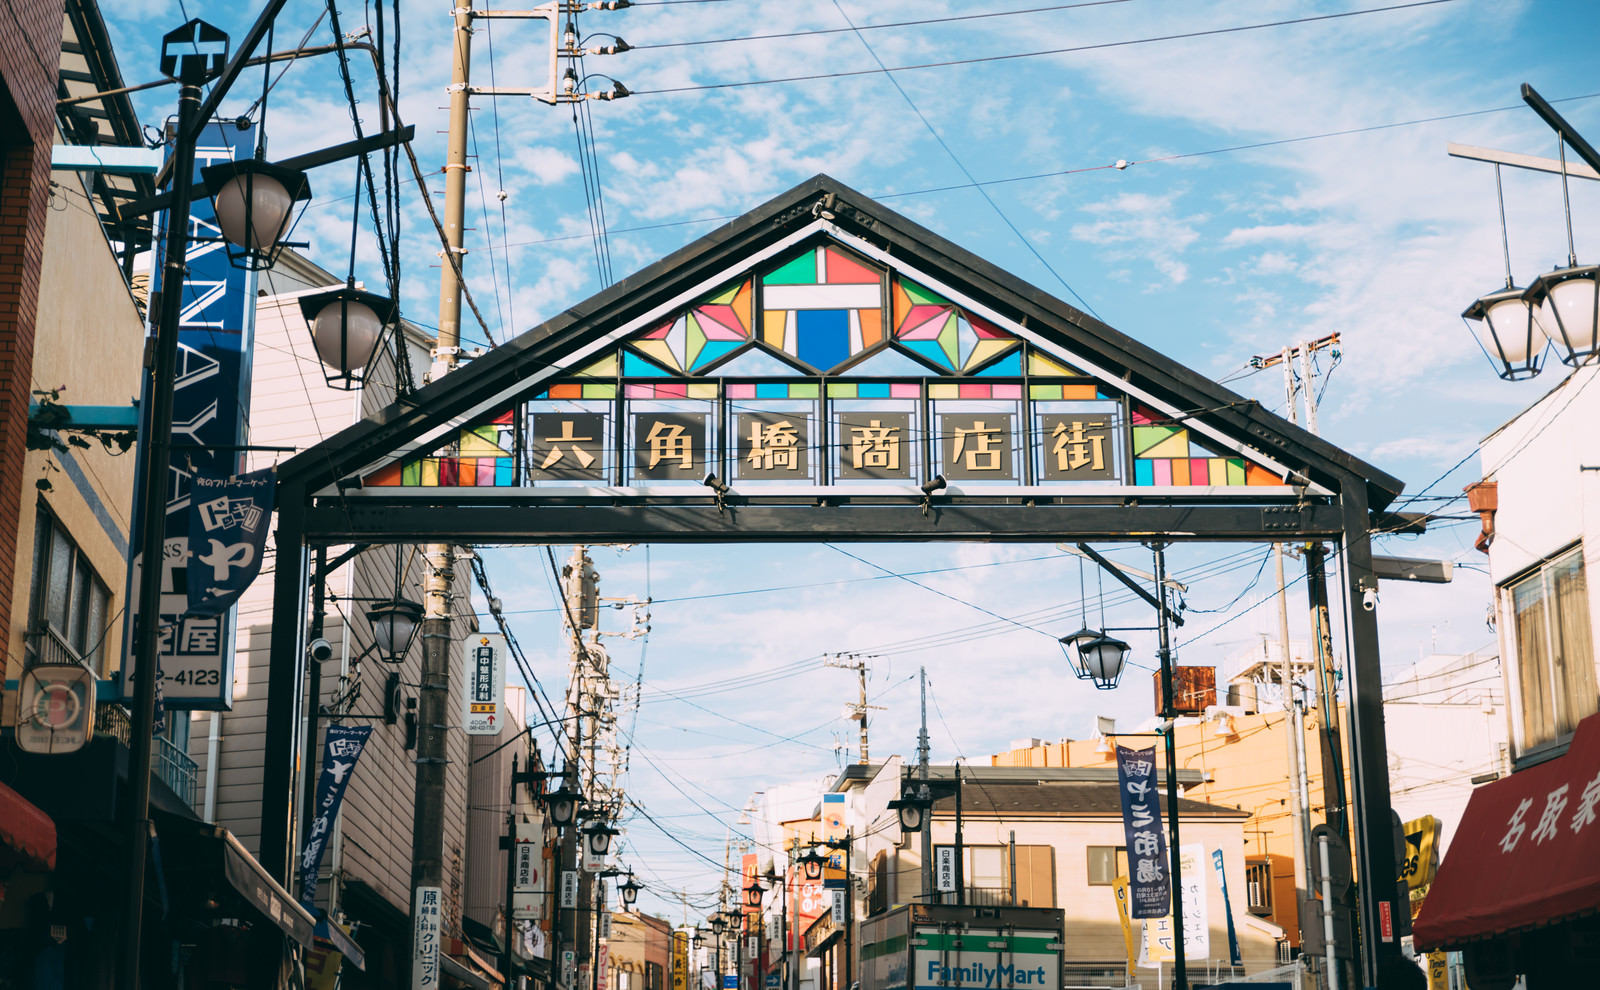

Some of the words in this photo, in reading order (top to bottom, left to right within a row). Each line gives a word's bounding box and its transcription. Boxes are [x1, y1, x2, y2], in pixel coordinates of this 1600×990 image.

[541, 420, 1104, 471] 六角橋商店街
[422, 890, 438, 906] 原
[420, 933, 434, 986] クリニック
[928, 960, 1046, 988] FamilyMart
